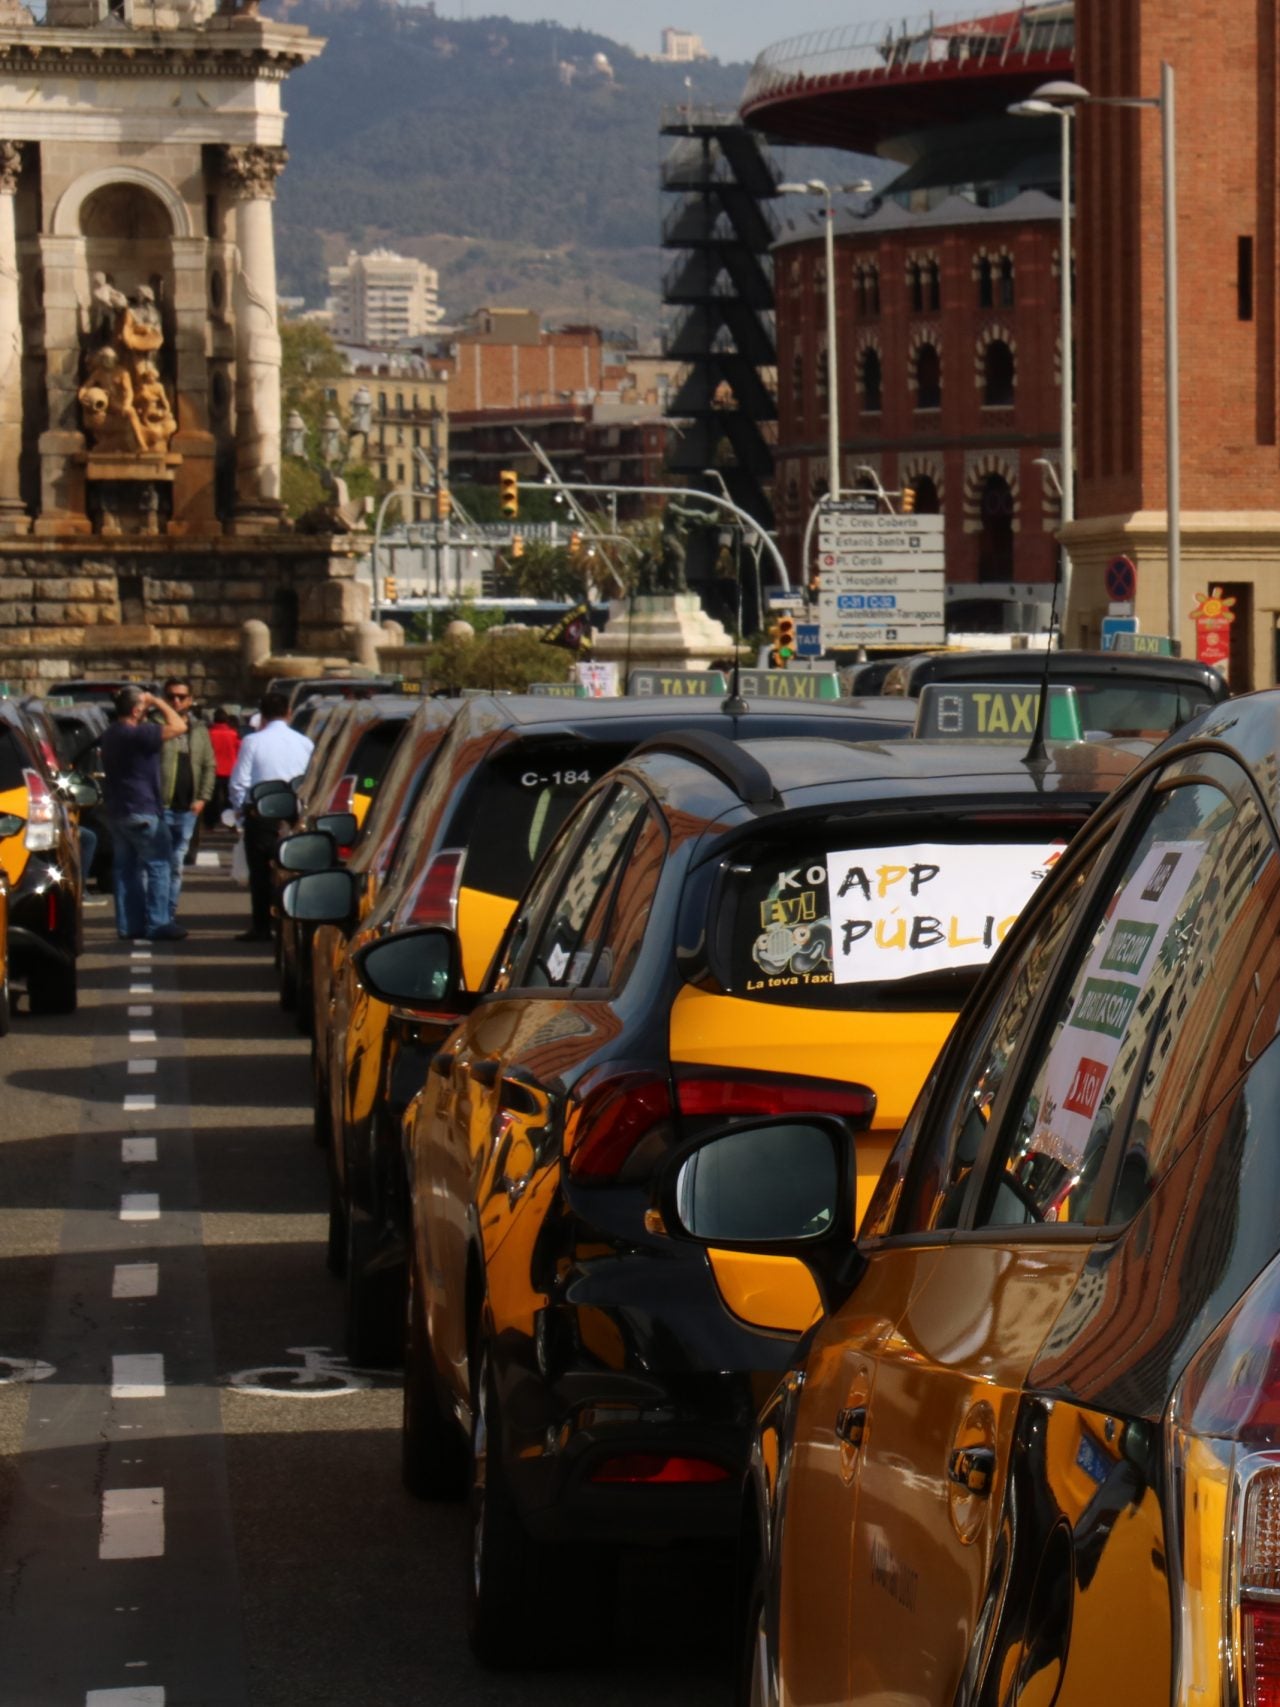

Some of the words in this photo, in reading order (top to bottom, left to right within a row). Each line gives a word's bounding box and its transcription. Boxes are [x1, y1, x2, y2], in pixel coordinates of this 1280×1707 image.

[1134, 636, 1159, 652] TAXI
[661, 678, 706, 695] TAXI
[766, 675, 815, 698] TAXI
[521, 770, 591, 786] C-184
[837, 863, 940, 901] APP
[746, 981, 764, 990] La
